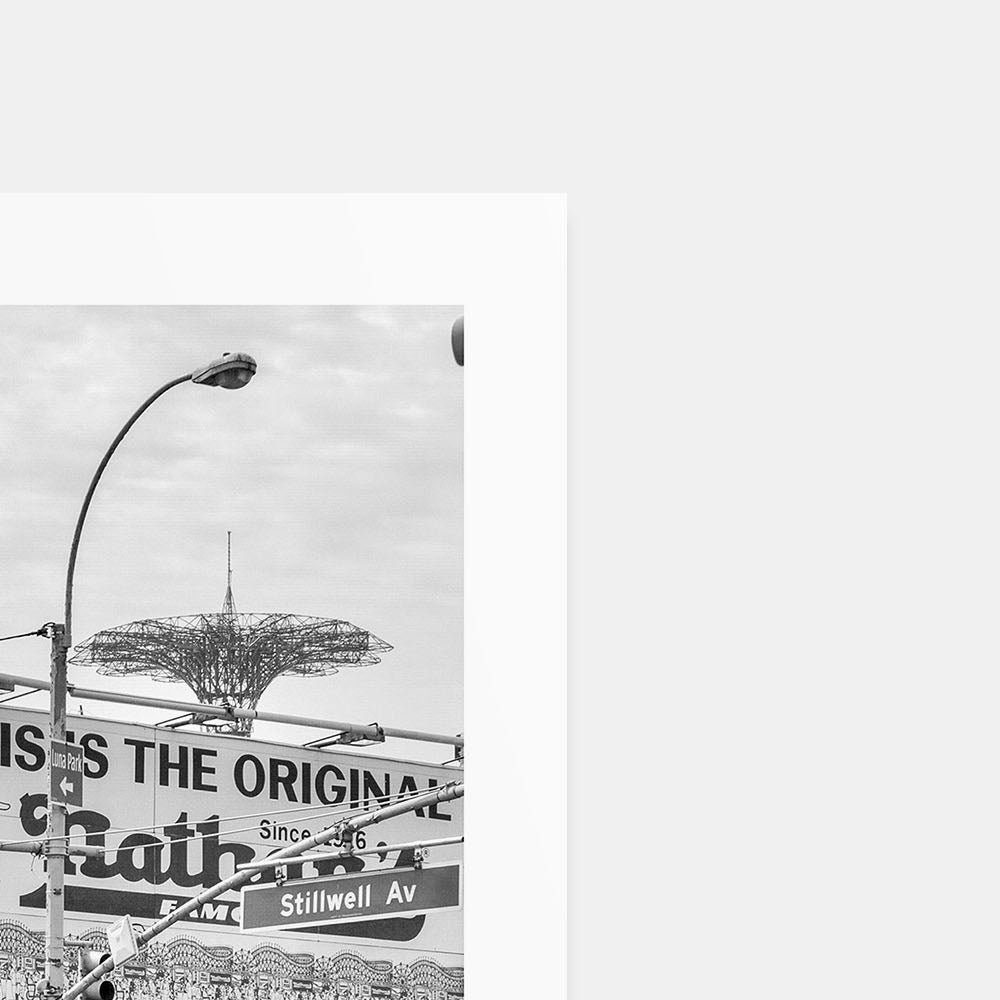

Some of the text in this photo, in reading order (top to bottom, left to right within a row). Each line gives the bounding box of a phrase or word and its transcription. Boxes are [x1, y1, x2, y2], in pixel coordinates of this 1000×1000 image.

[51, 748, 83, 772] Luna Park
[124, 738, 218, 793] THE
[233, 753, 452, 822] ORIGINAL
[259, 819, 312, 843] Since
[279, 880, 417, 918] Stillwell Av
